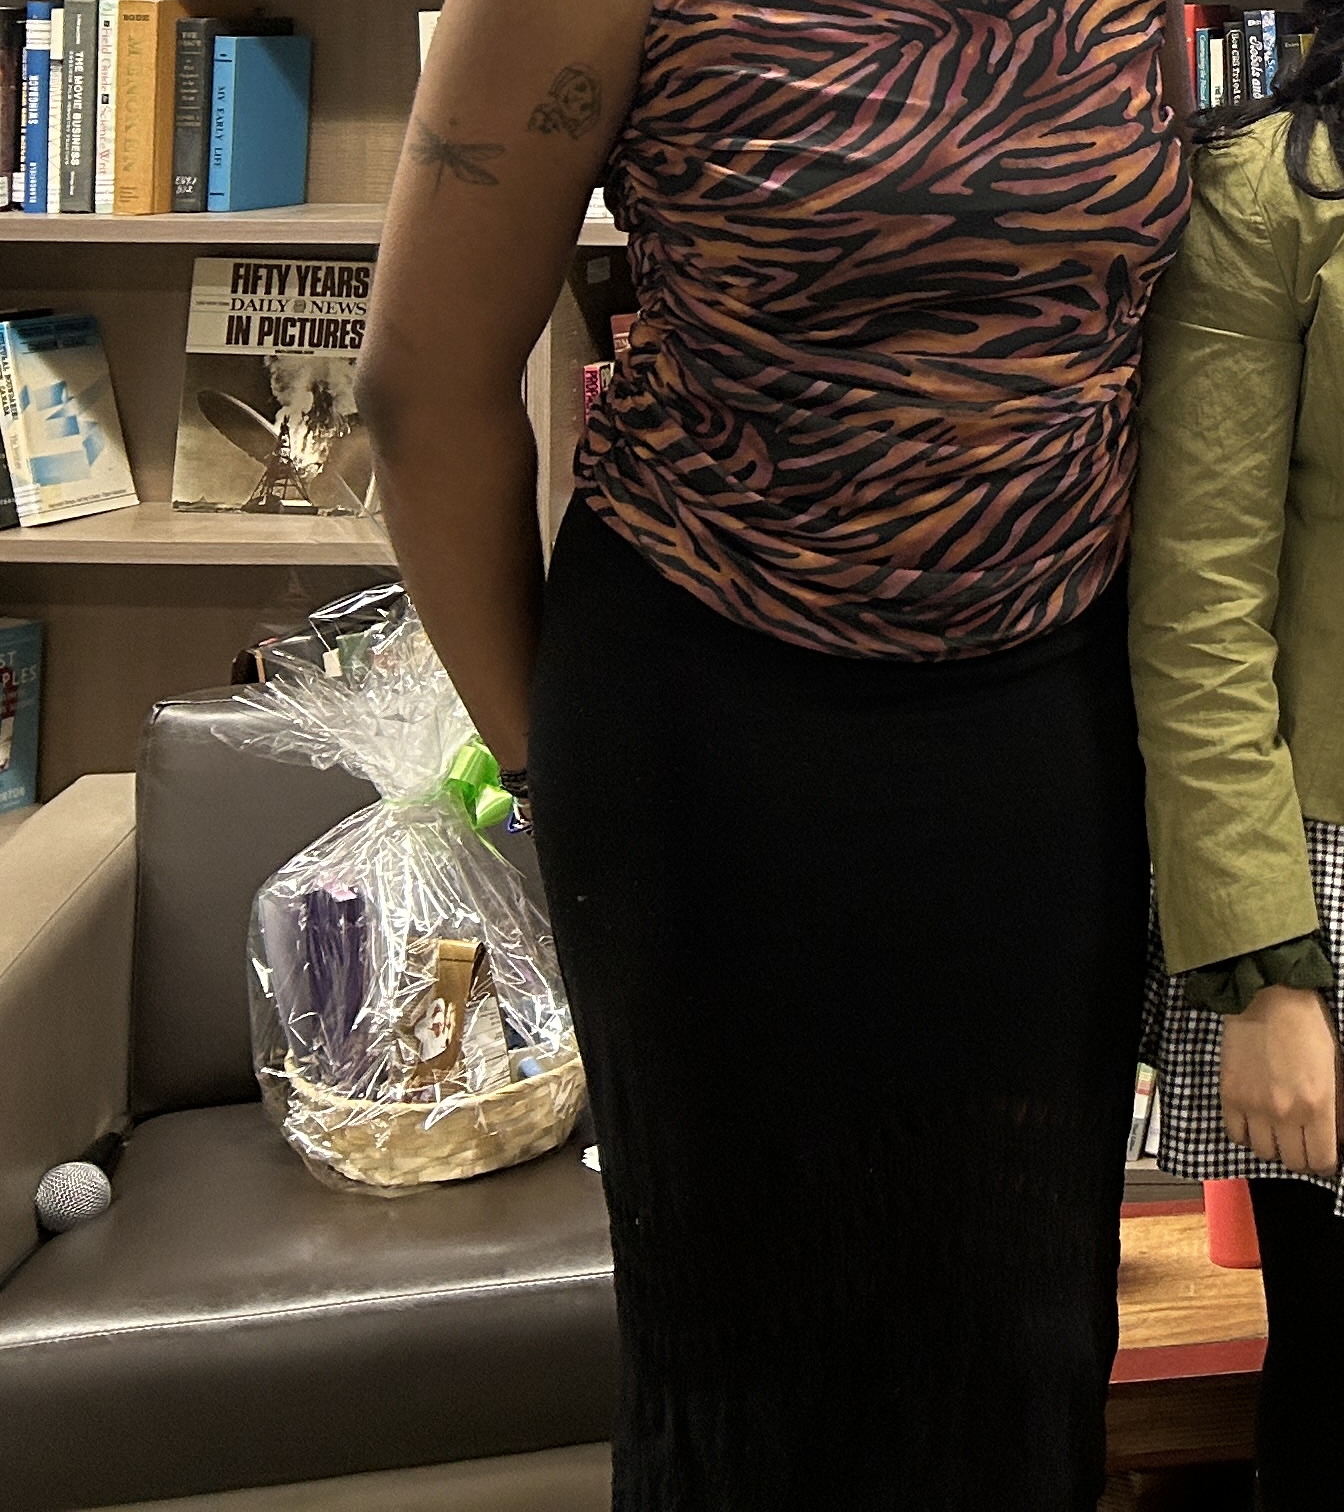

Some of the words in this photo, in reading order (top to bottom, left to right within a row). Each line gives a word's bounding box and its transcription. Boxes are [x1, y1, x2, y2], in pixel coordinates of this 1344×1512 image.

[73, 50, 84, 72] THE
[27, 74, 40, 124] SWINGBACK
[71, 74, 83, 110] MOVIE
[216, 85, 226, 101] MY
[69, 112, 82, 166] BUSINESS
[214, 107, 225, 140] EARLY
[213, 147, 223, 168] LIFE
[230, 262, 291, 296] FIFTY
[296, 264, 371, 298] YEARS
[230, 298, 290, 313] DAILY
[309, 300, 368, 316] NEWS
[225, 314, 252, 345] IN
[256, 316, 367, 349] PICTURES
